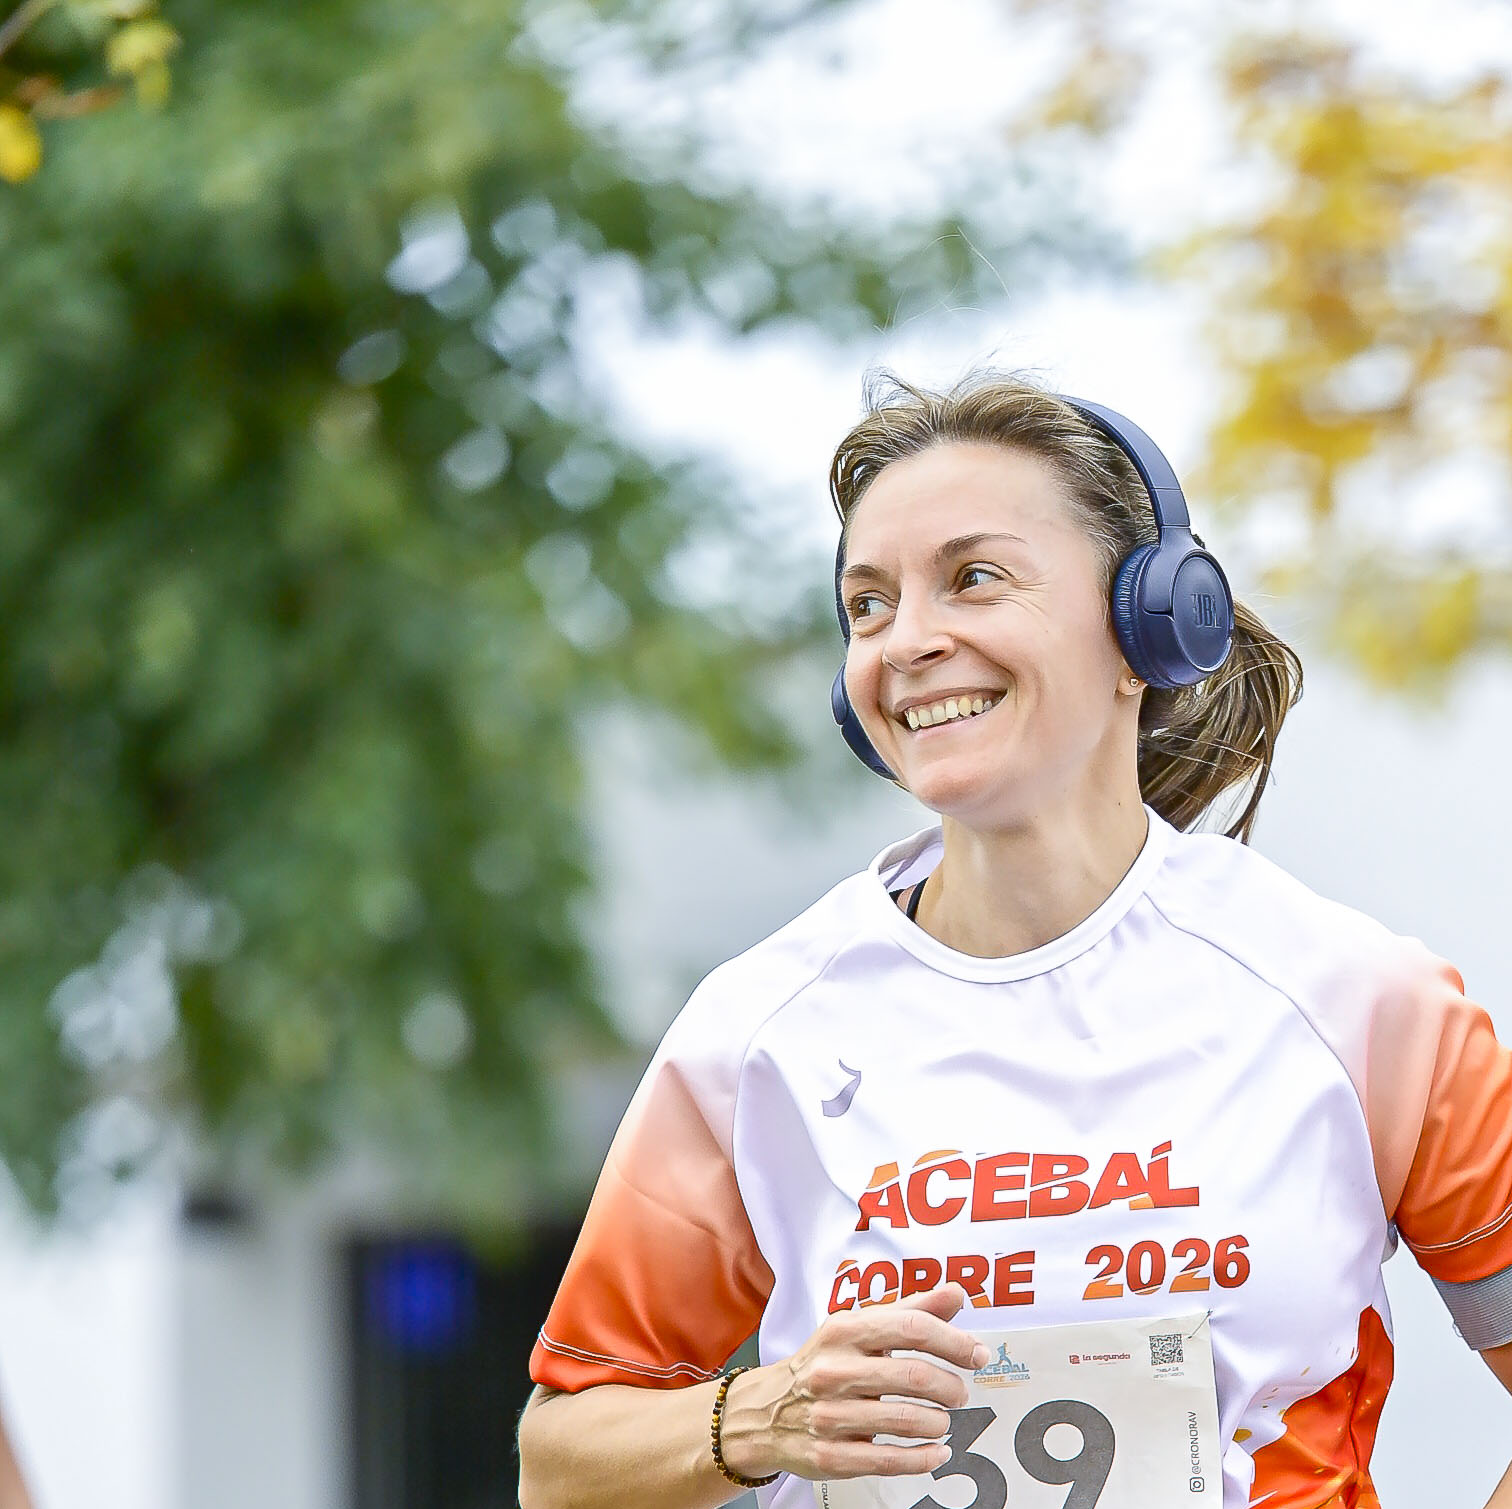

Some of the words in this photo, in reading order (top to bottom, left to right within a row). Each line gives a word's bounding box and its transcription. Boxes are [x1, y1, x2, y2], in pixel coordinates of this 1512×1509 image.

[1191, 593, 1222, 628] JBL
[855, 1140, 1200, 1232] ACEBAL
[1082, 1234, 1251, 1301] 2026
[1188, 1411, 1202, 1475] @CRONORAV
